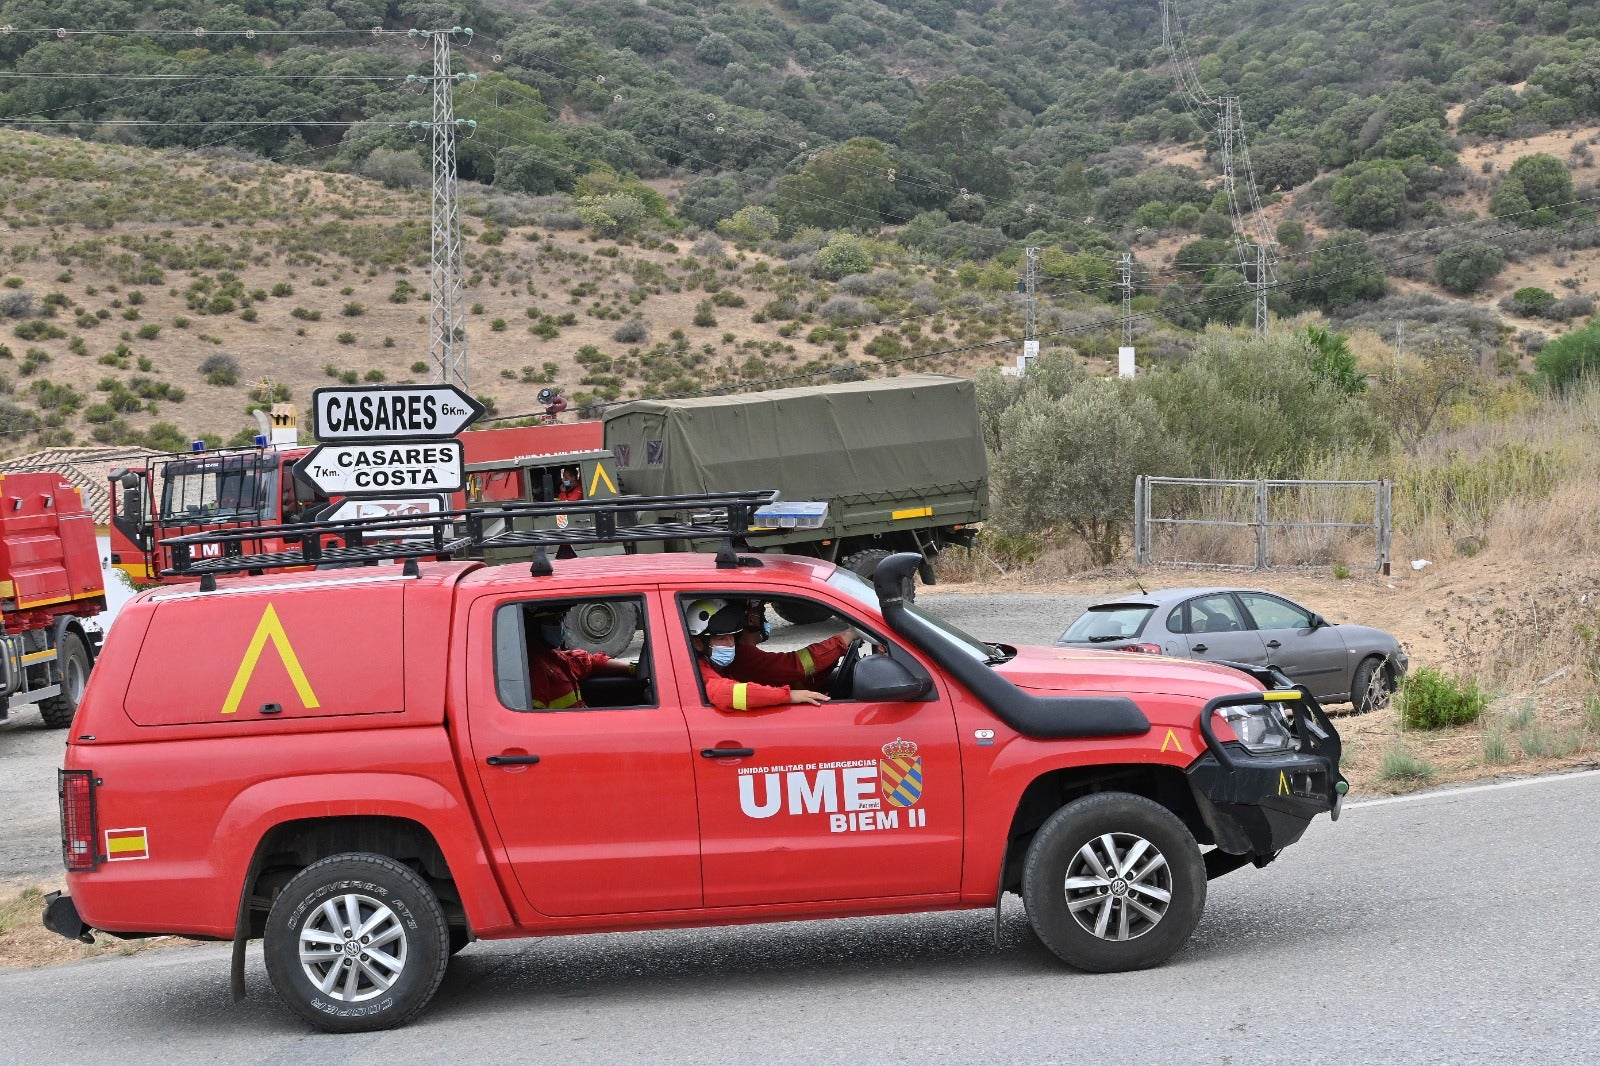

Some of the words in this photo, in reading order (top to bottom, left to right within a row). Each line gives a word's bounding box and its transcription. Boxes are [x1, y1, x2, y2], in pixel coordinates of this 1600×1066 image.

[326, 395, 437, 432] CASARES
[337, 447, 453, 468] CASARES
[355, 468, 438, 487] COSTA
[737, 767, 769, 775] UNIDAD
[771, 764, 804, 773] MILITAR
[819, 759, 877, 769] EMERGENCIAS
[738, 766, 880, 818] UME
[830, 810, 898, 832] BIEM
[908, 808, 926, 828] II
[287, 880, 389, 930] DISCOVERER
[310, 996, 393, 1017] COOPER
